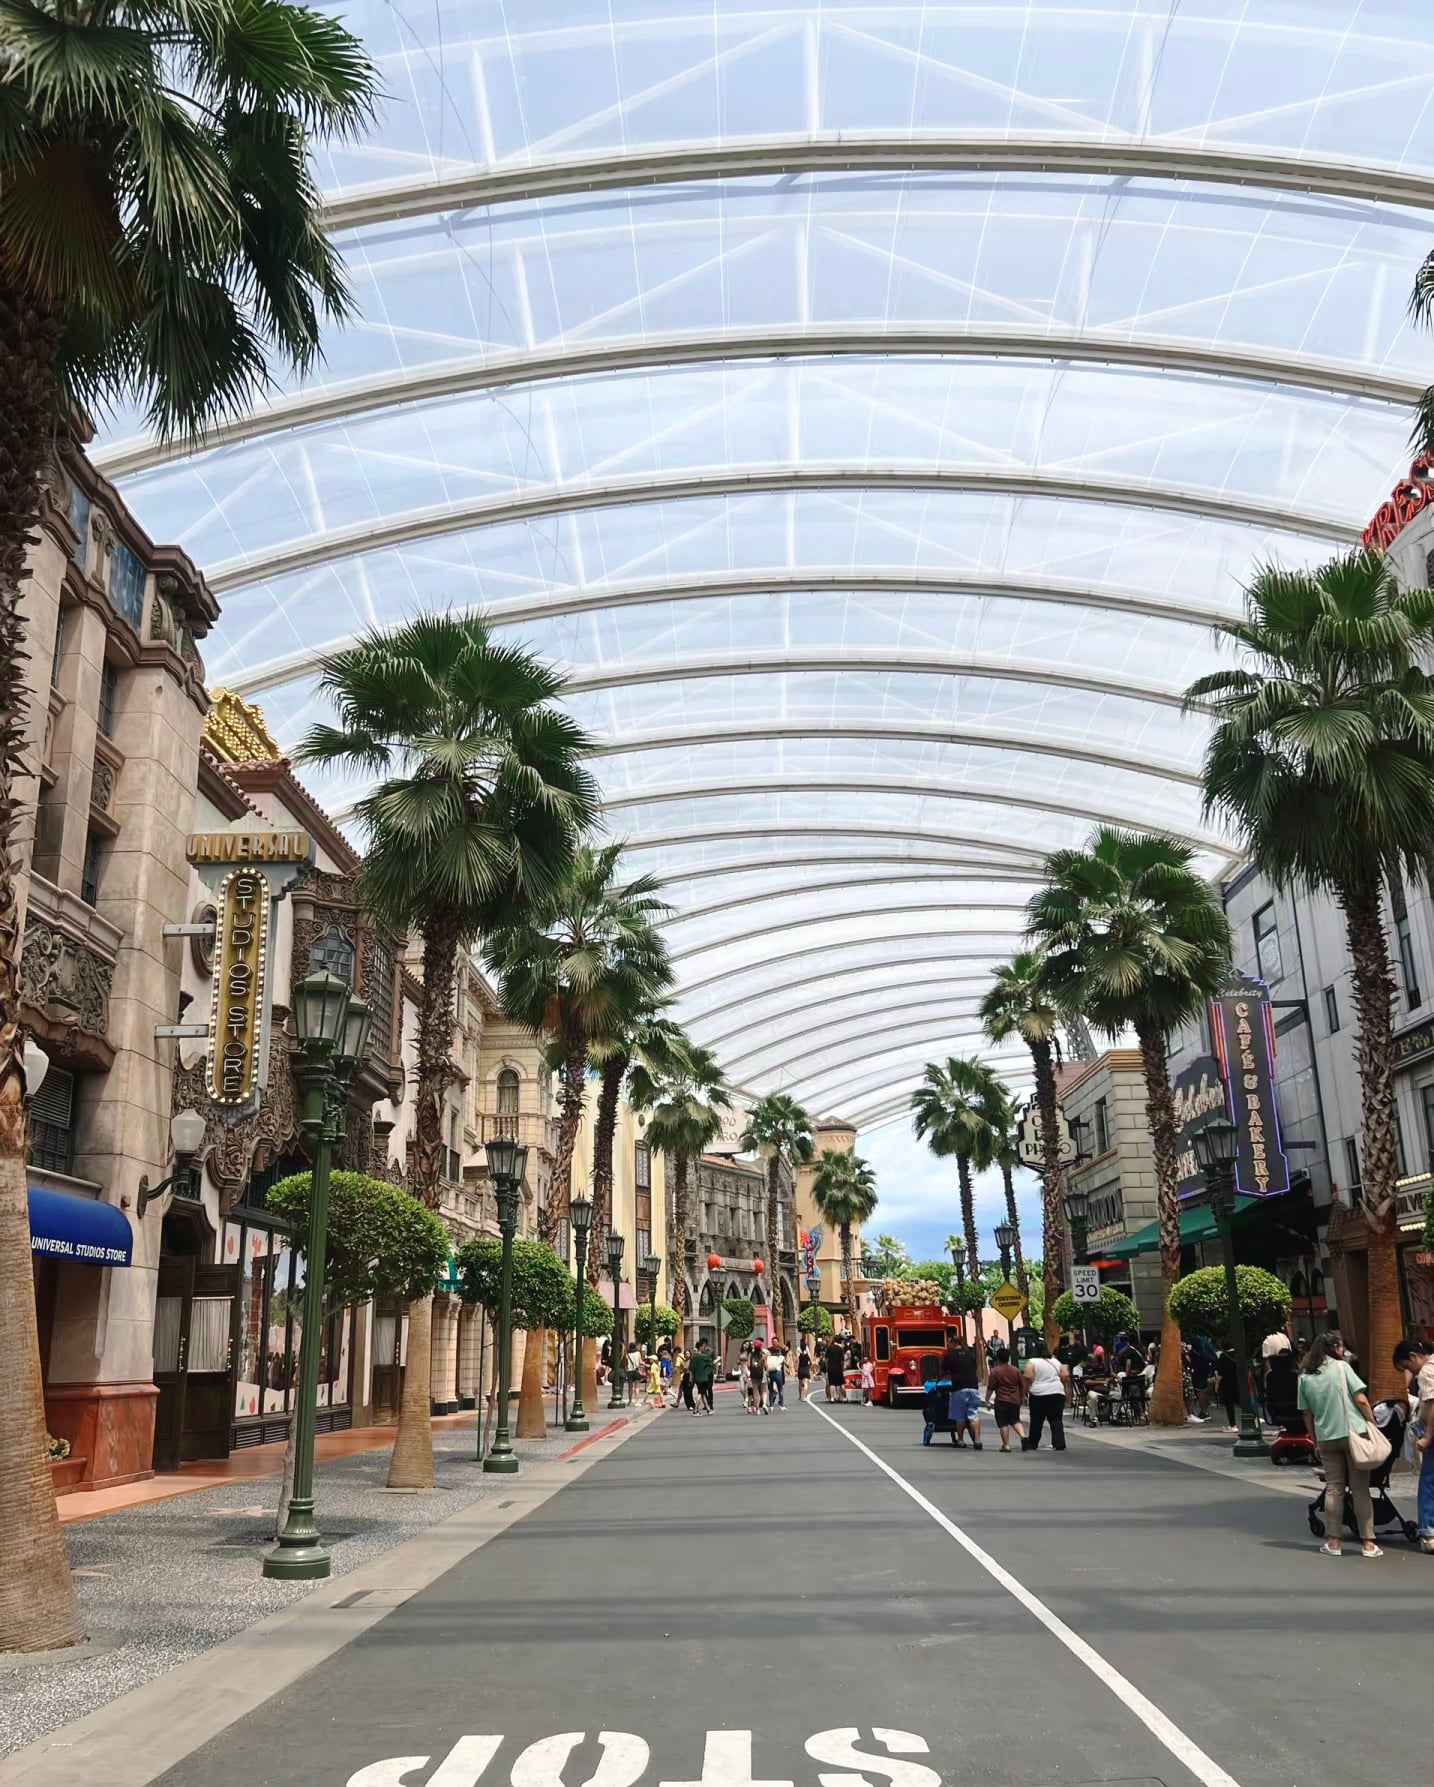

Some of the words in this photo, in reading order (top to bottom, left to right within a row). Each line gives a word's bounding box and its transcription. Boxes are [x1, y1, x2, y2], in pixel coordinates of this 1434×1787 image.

[187, 833, 303, 858] UNIVERSAL
[228, 878, 255, 996] STUDIOS
[1215, 988, 1263, 999] Celebrity
[222, 1006, 248, 1093] STORE
[1246, 1094, 1269, 1194] BAKERY
[31, 1236, 74, 1254] UNIVERSAL
[75, 1244, 105, 1259] STUDIOS
[105, 1248, 127, 1262] STORE
[1075, 1284, 1098, 1297] 30
